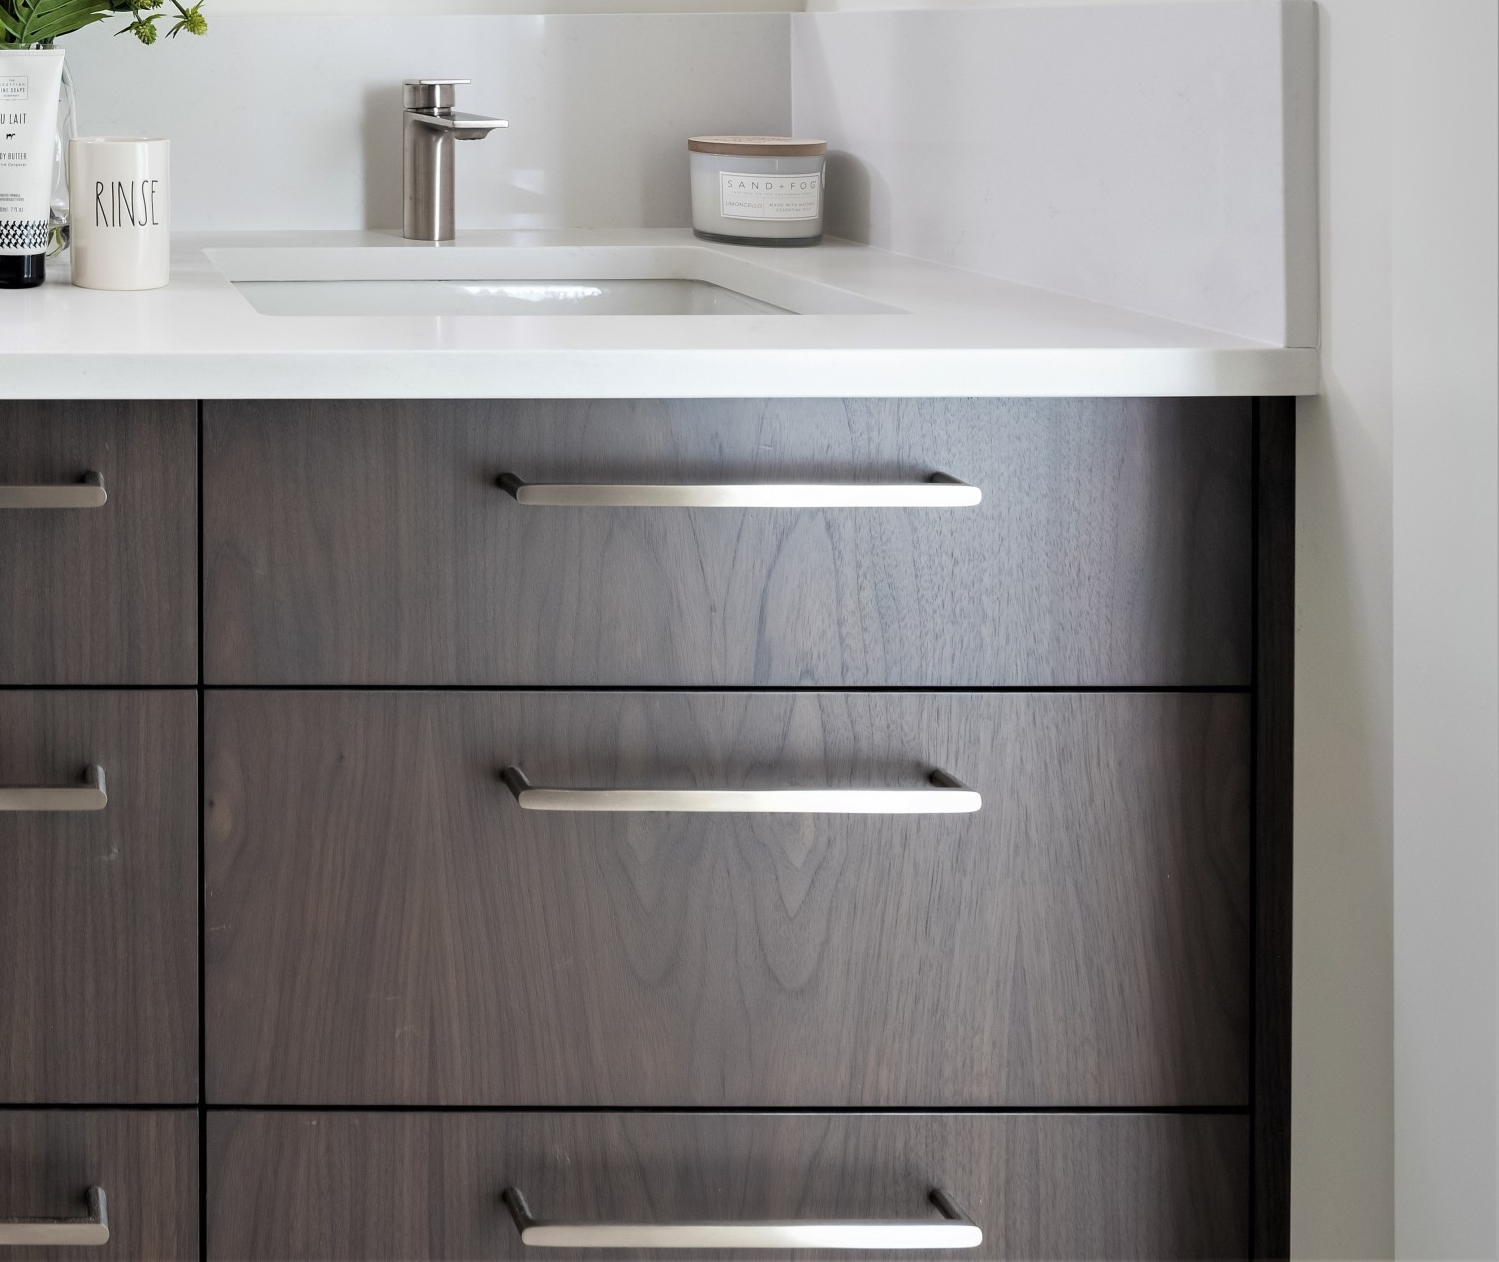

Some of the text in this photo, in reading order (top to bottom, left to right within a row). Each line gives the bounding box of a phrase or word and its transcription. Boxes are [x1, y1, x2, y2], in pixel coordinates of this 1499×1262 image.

[9, 113, 27, 125] LAIT
[8, 152, 27, 160] BUTTER
[727, 180, 773, 190] SAND
[790, 181, 816, 190] FOG
[96, 180, 159, 227] RINSE
[725, 201, 763, 209] LIMONCELLO
